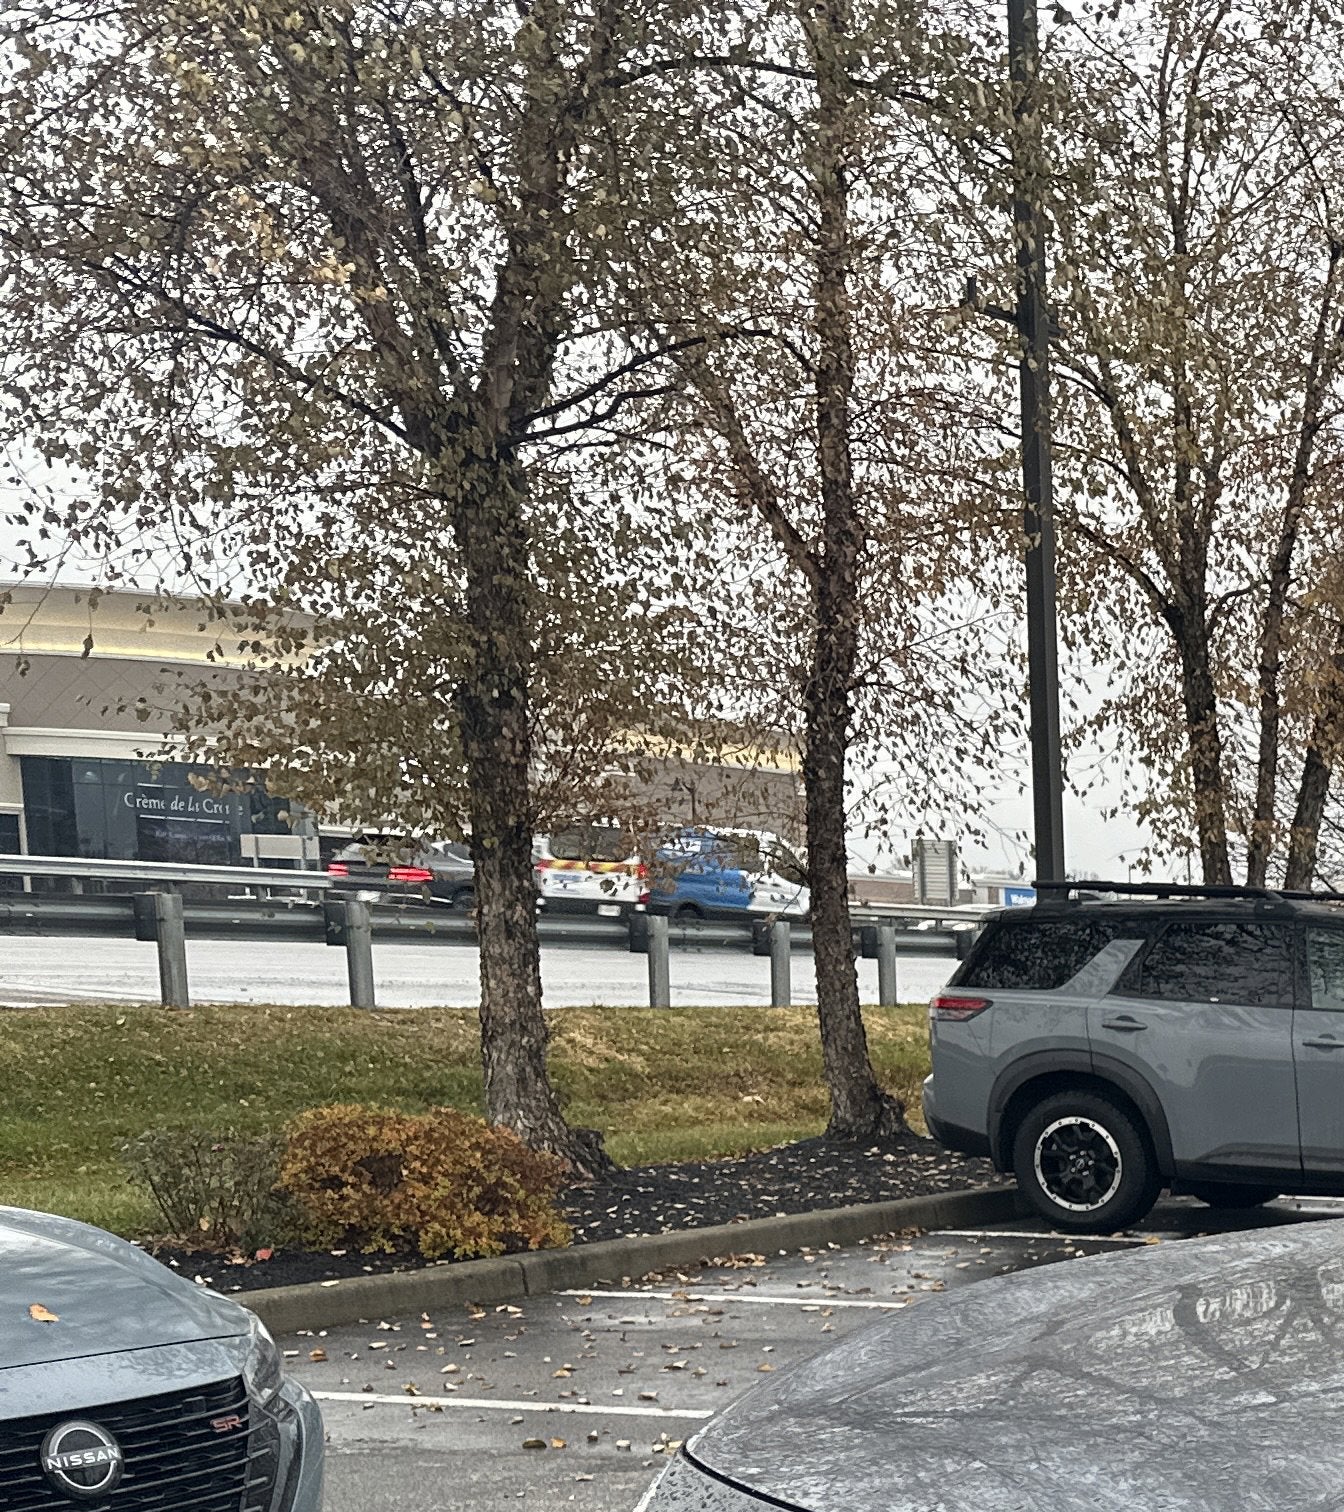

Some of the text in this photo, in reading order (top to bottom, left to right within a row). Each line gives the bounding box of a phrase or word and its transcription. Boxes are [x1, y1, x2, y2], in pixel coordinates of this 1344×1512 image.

[171, 795, 185, 811] de
[210, 1414, 242, 1433] SR
[47, 1447, 121, 1470] NISSAN
